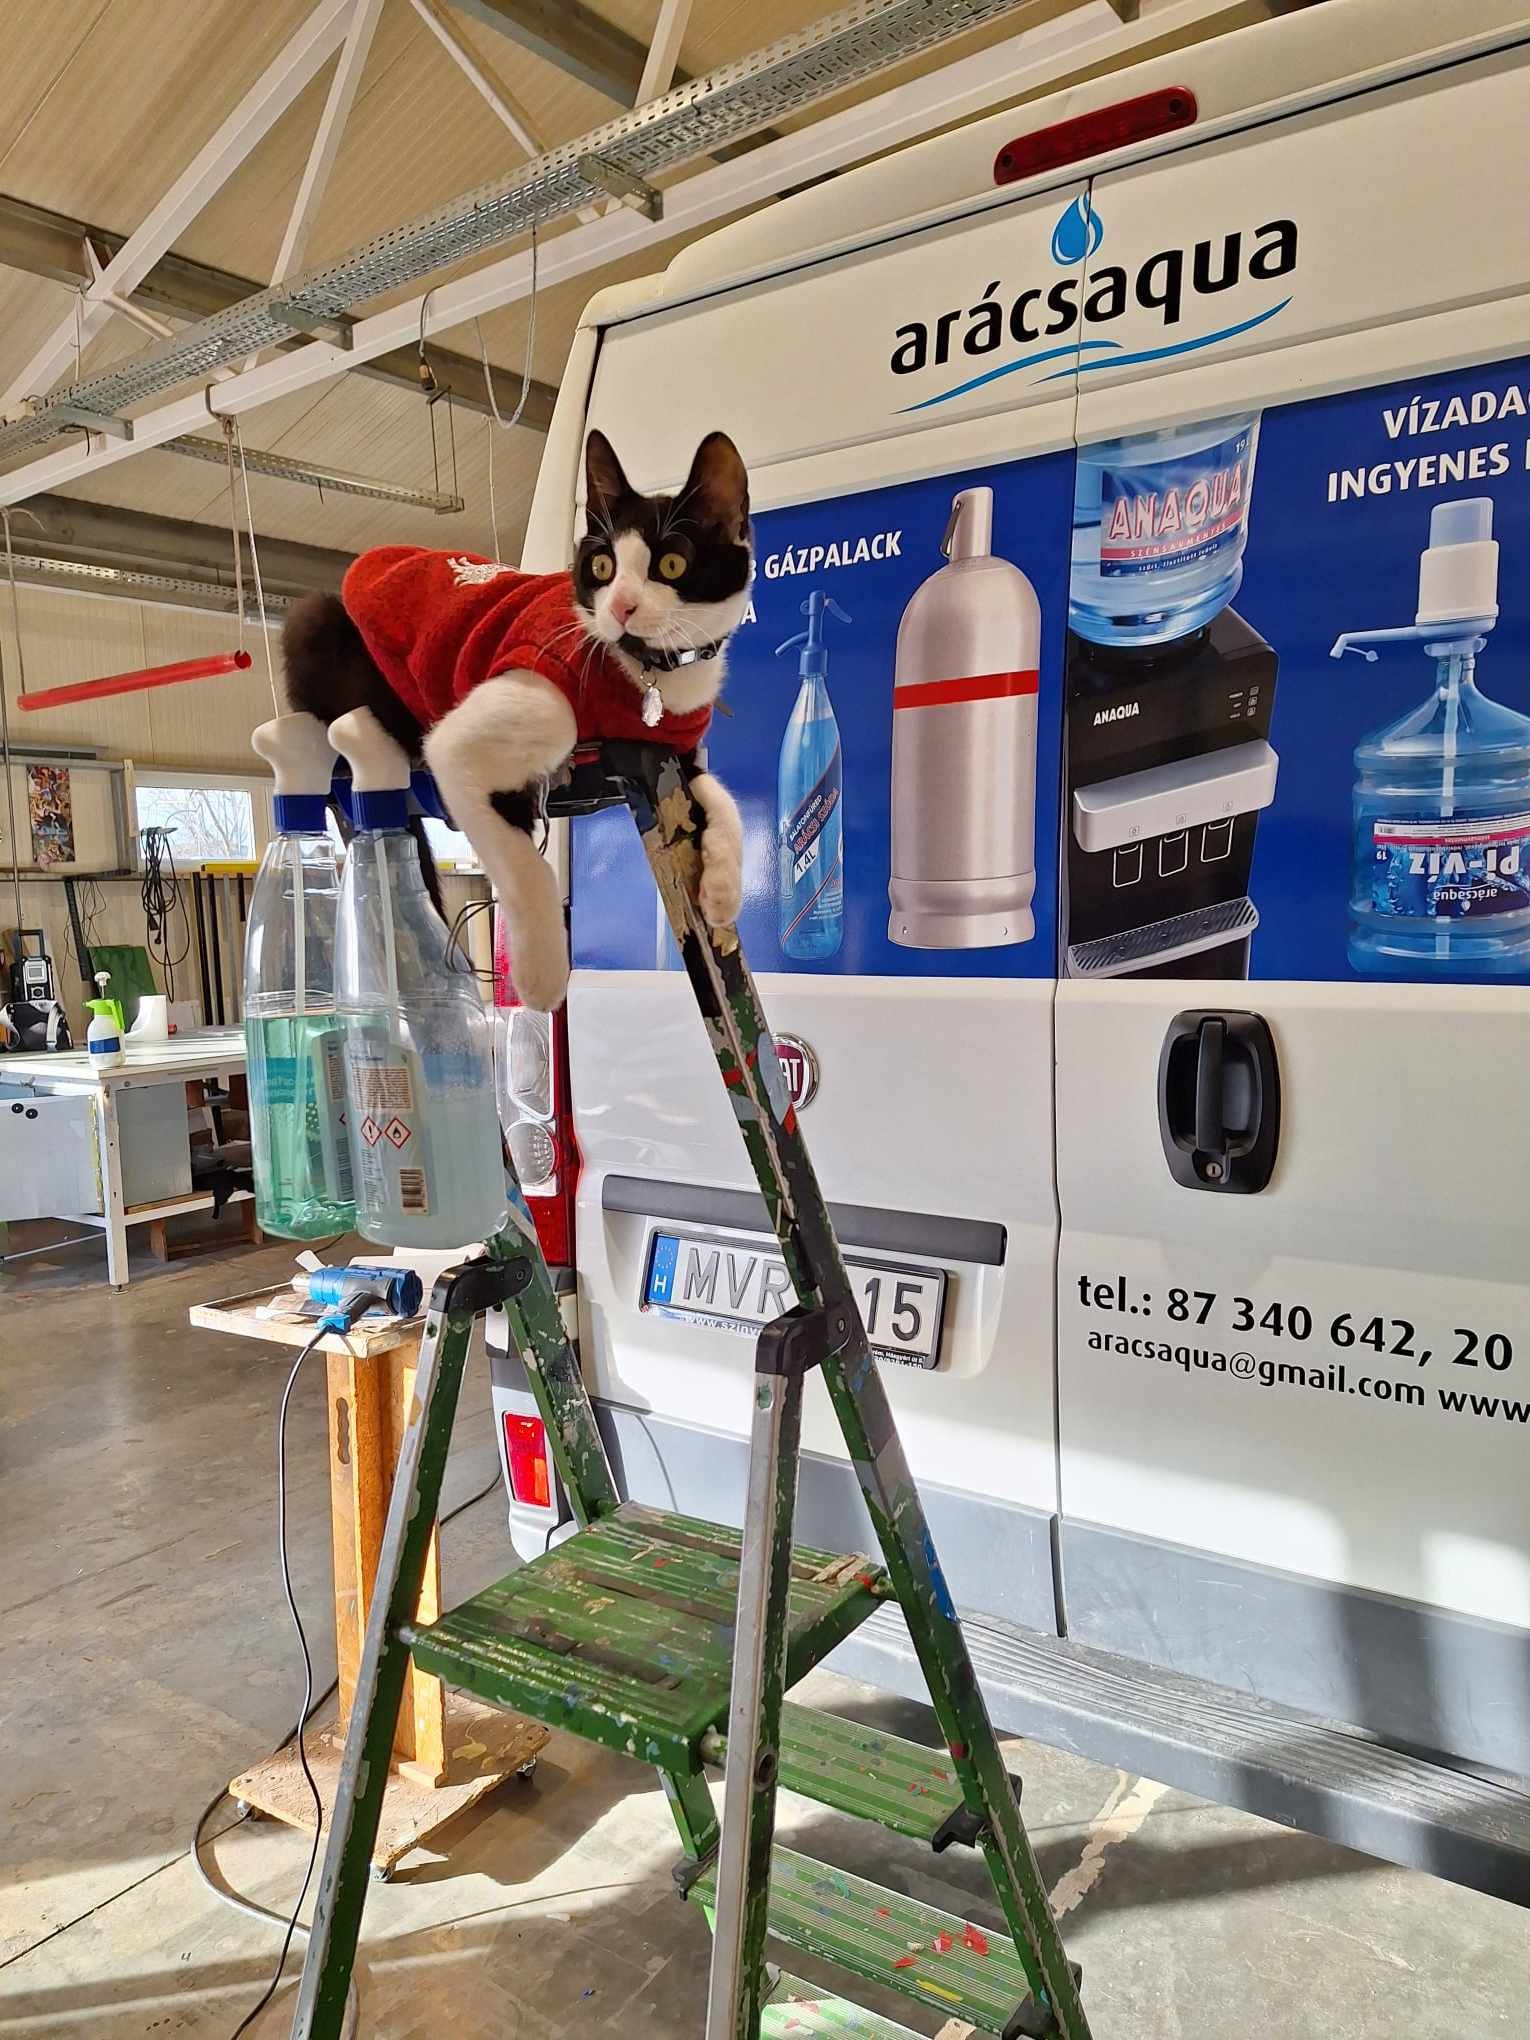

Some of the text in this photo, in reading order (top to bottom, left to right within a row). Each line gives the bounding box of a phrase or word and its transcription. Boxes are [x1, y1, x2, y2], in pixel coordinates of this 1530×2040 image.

[890, 219, 1299, 375] arácsaqua
[1382, 384, 1530, 440] VÍZADA
[1327, 442, 1511, 503] INGYENES
[1108, 463, 1244, 540] ANAQUA
[764, 530, 903, 579] GÁZPALACK
[1093, 701, 1140, 727] ANAQUA
[1409, 845, 1520, 883] pi-víz
[778, 1057, 801, 1092] AT
[653, 1274, 667, 1294] H
[1078, 1275, 1513, 1371] tel.: 87 340 642, 20
[1088, 1331, 1425, 1406] aracsaqua@gmail.com
